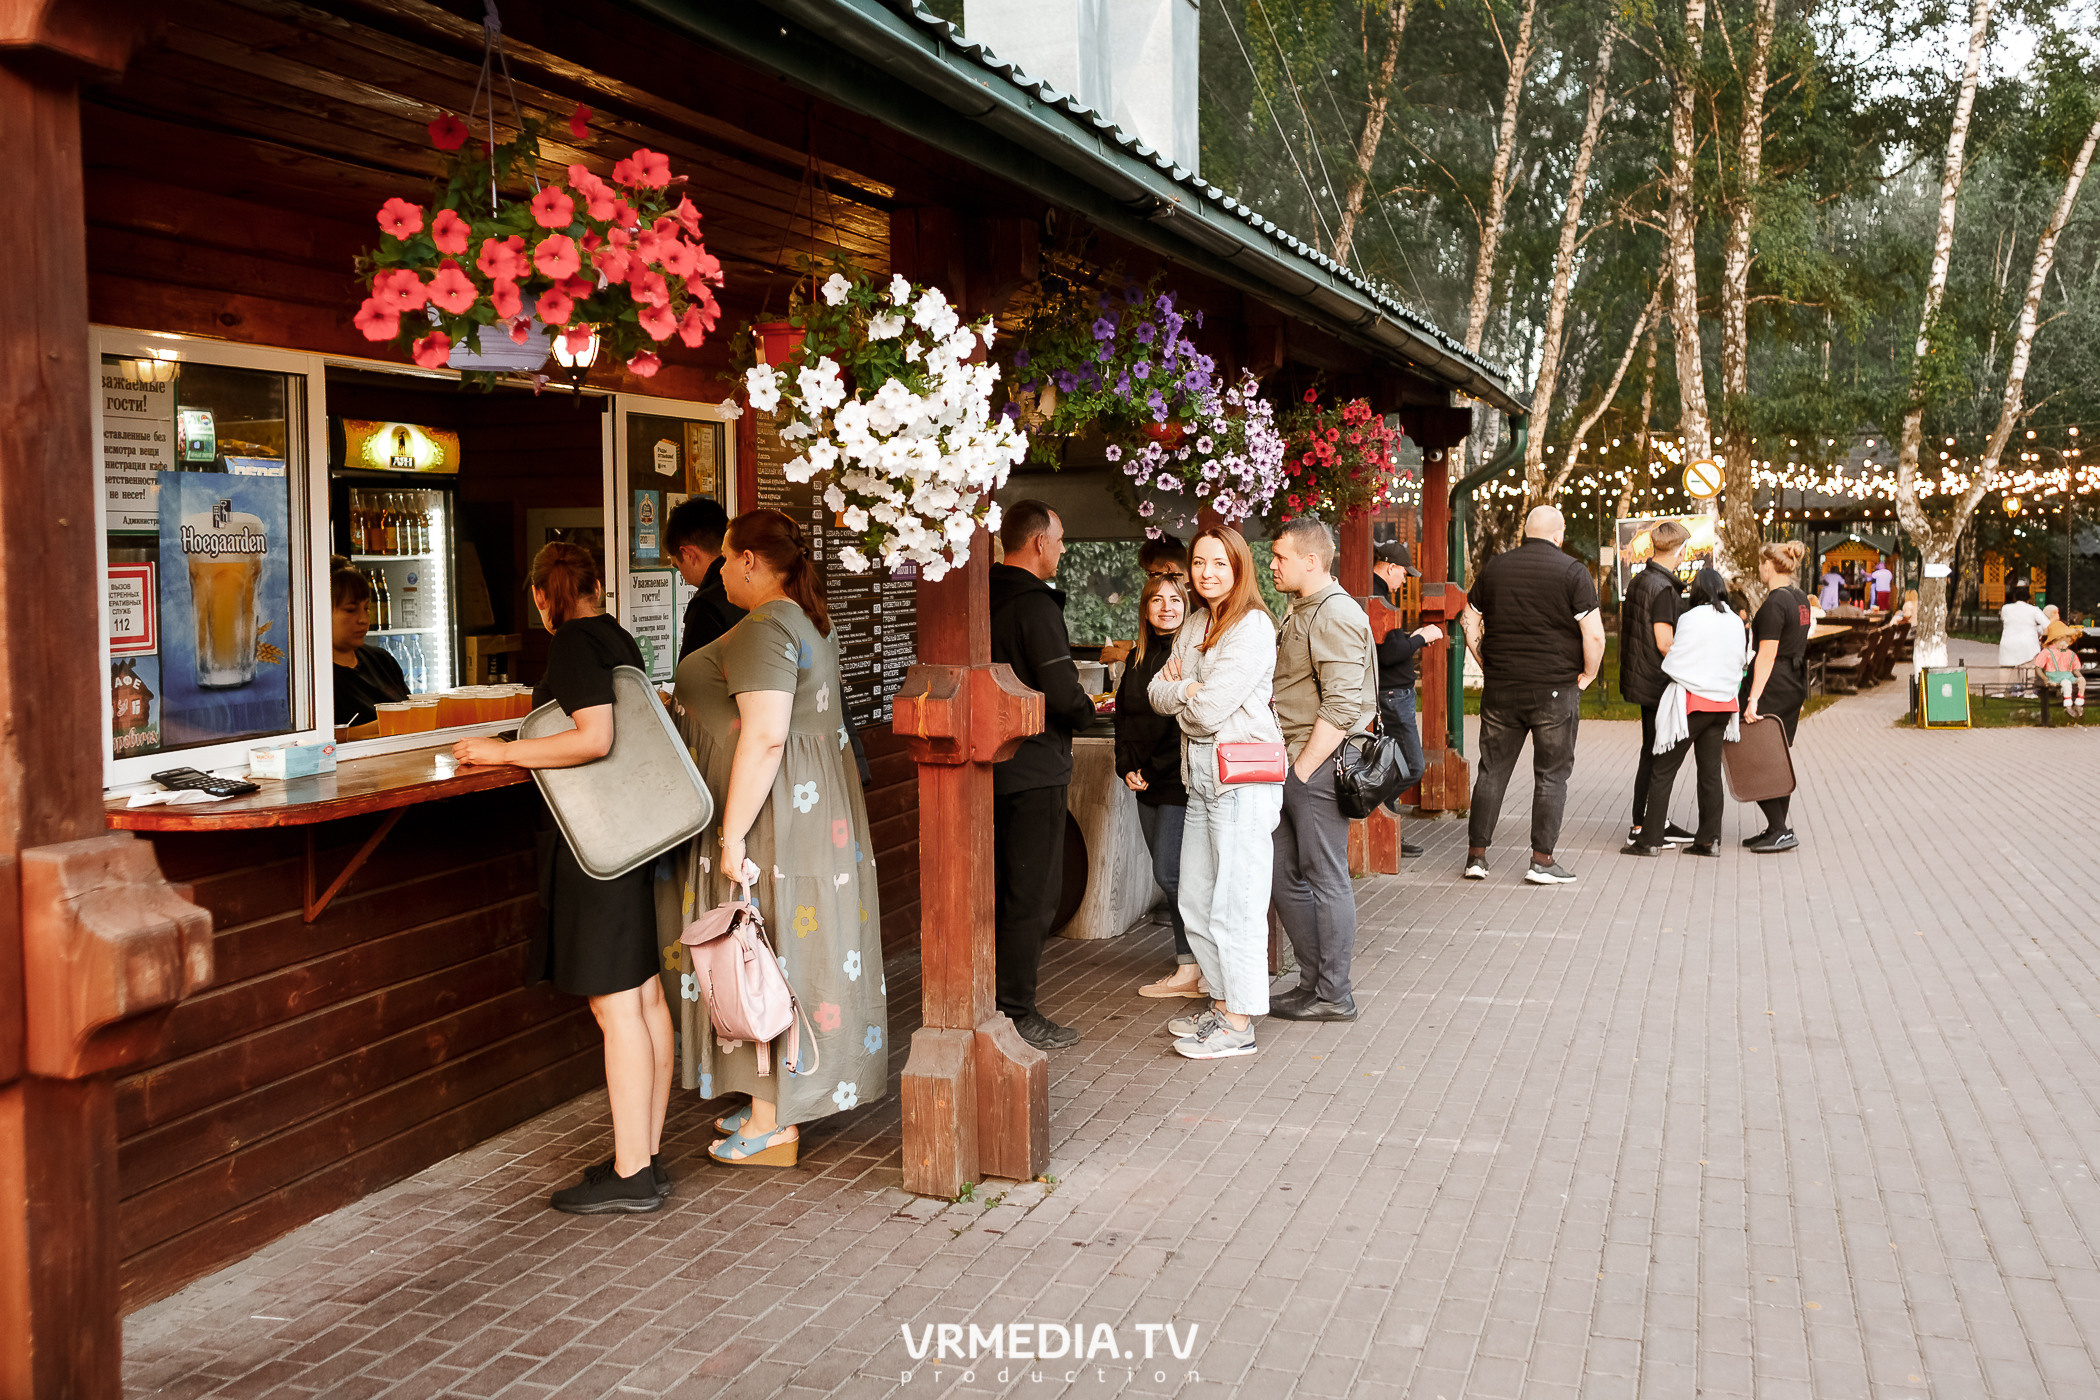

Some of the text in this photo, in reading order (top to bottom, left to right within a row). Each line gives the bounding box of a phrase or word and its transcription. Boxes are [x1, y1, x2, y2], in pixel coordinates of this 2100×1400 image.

[106, 394, 147, 413] гости!
[153, 431, 167, 443] без
[139, 447, 160, 458] вещи
[149, 462, 168, 473] кафе
[109, 488, 146, 500] не несет!
[180, 525, 268, 558] Hoegaarden
[110, 583, 132, 591] ВЫЗОВ
[632, 576, 669, 589] Уважаемые
[641, 589, 661, 603] гости!
[112, 607, 132, 615] СЛУЖБ
[113, 618, 131, 632] 112
[114, 675, 142, 690] АФЕ
